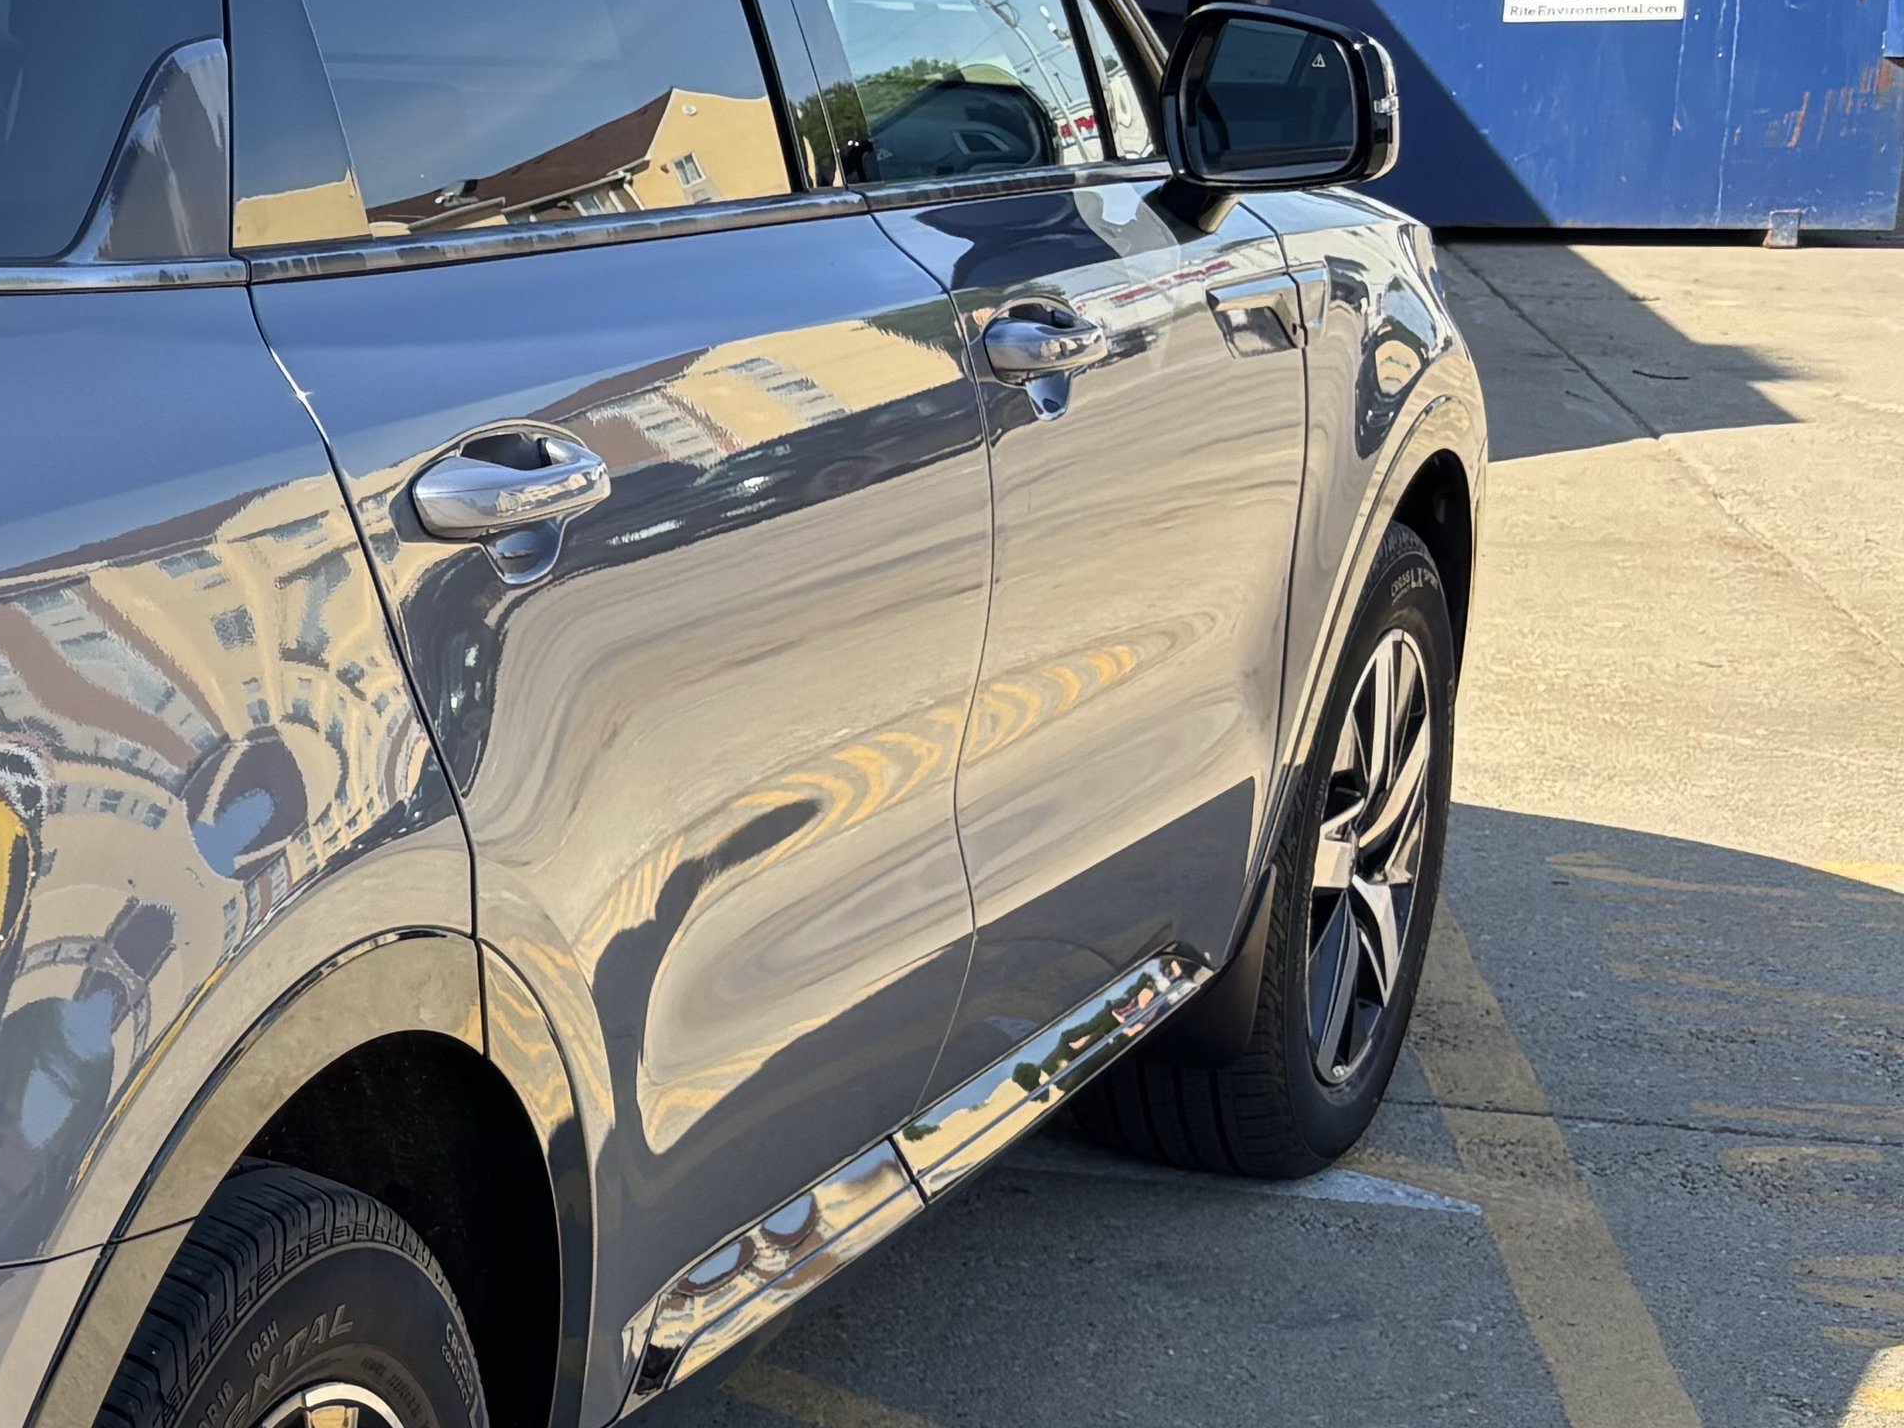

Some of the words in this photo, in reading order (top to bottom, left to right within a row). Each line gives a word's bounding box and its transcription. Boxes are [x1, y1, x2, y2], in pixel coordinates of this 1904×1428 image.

[1510, 5, 1678, 17] RiteEnvironmental.com
[245, 1320, 280, 1367] 103H
[445, 1322, 475, 1396] CROSS
